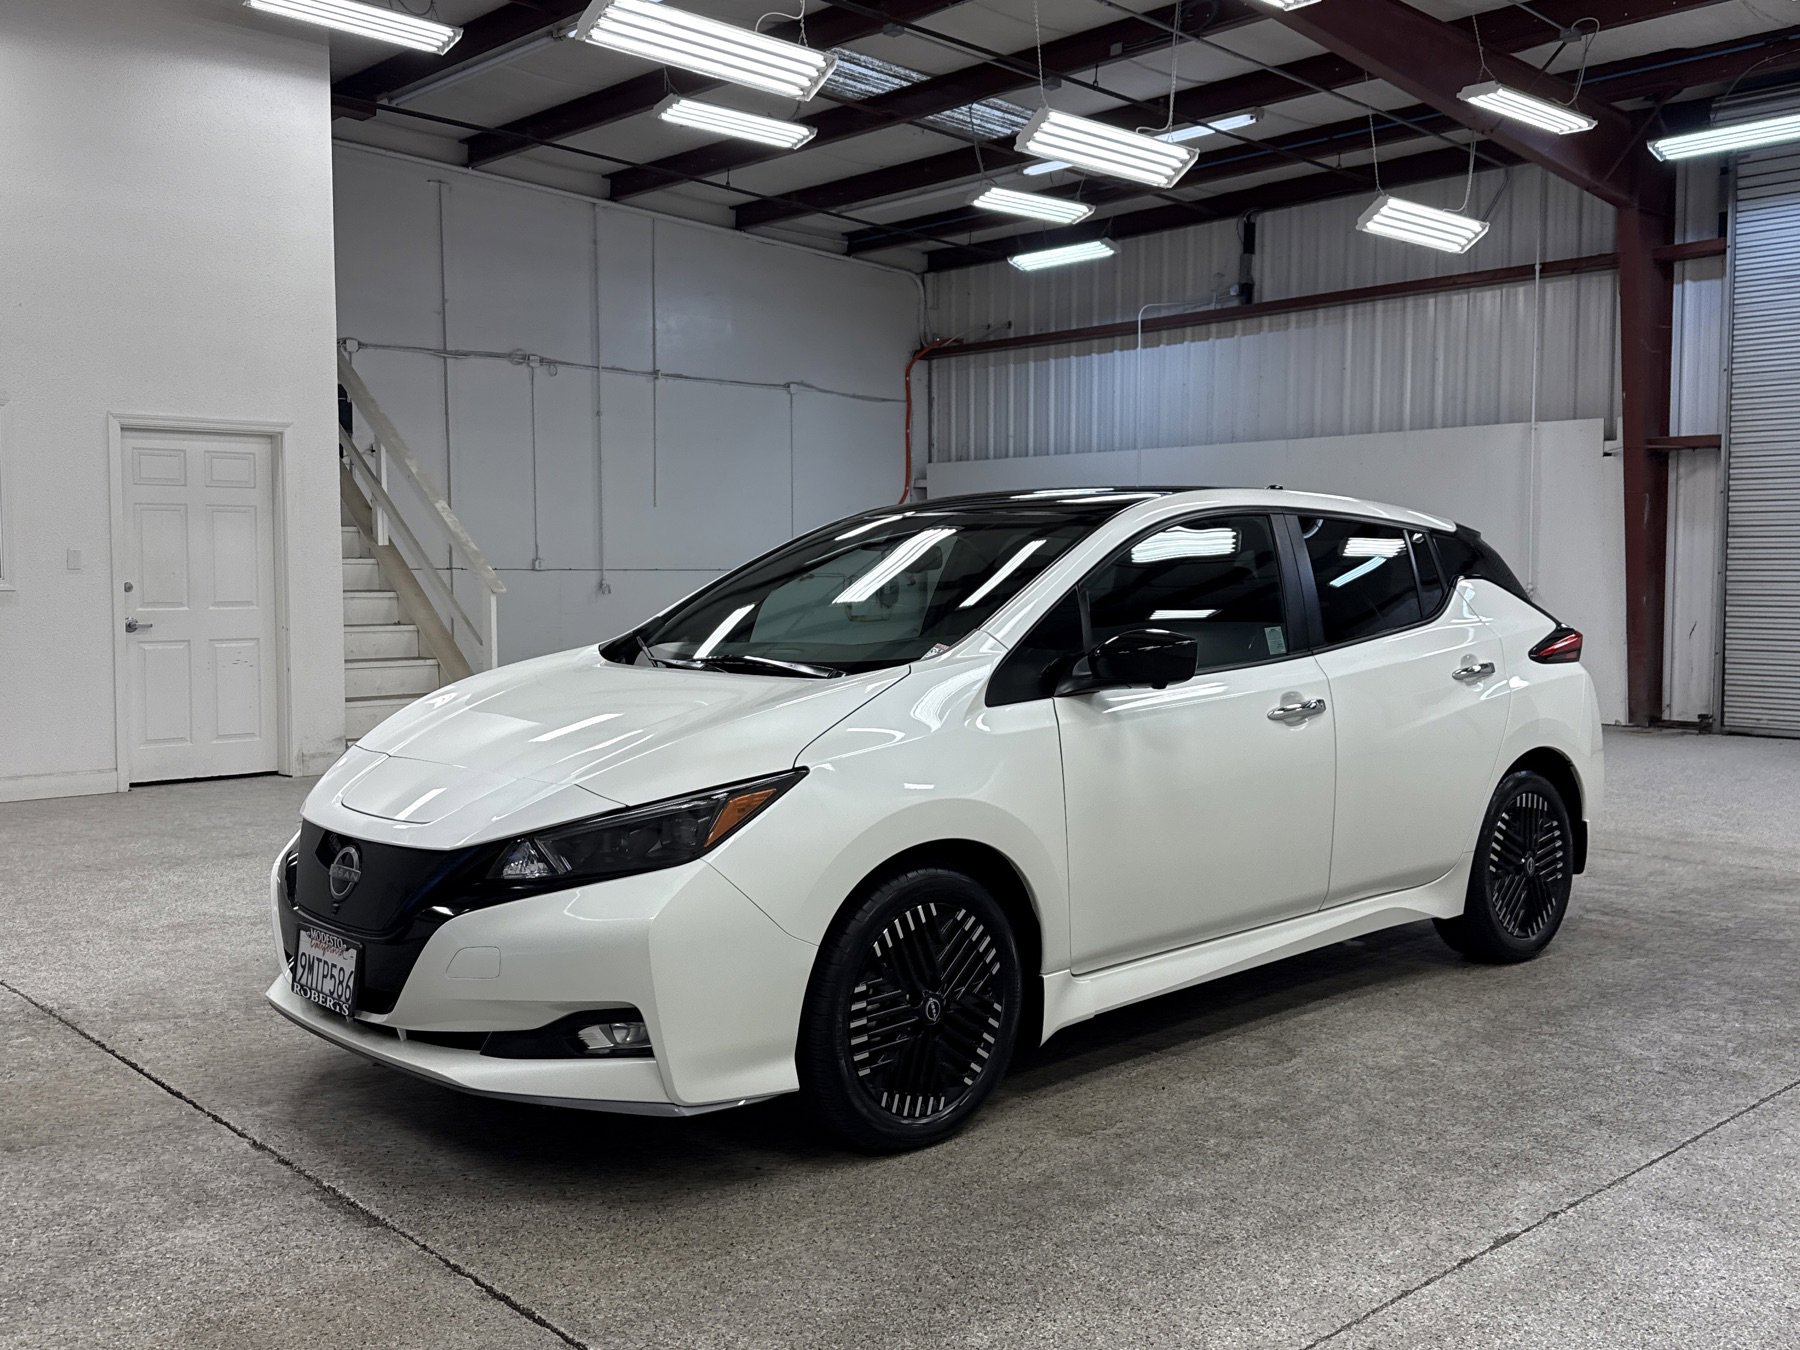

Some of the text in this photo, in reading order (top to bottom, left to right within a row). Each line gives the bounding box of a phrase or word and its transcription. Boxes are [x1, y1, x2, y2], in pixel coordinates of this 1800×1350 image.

[310, 928, 344, 949] MODESTO
[297, 952, 354, 1003] 9MTP586
[293, 982, 350, 1016] ROBERTS
